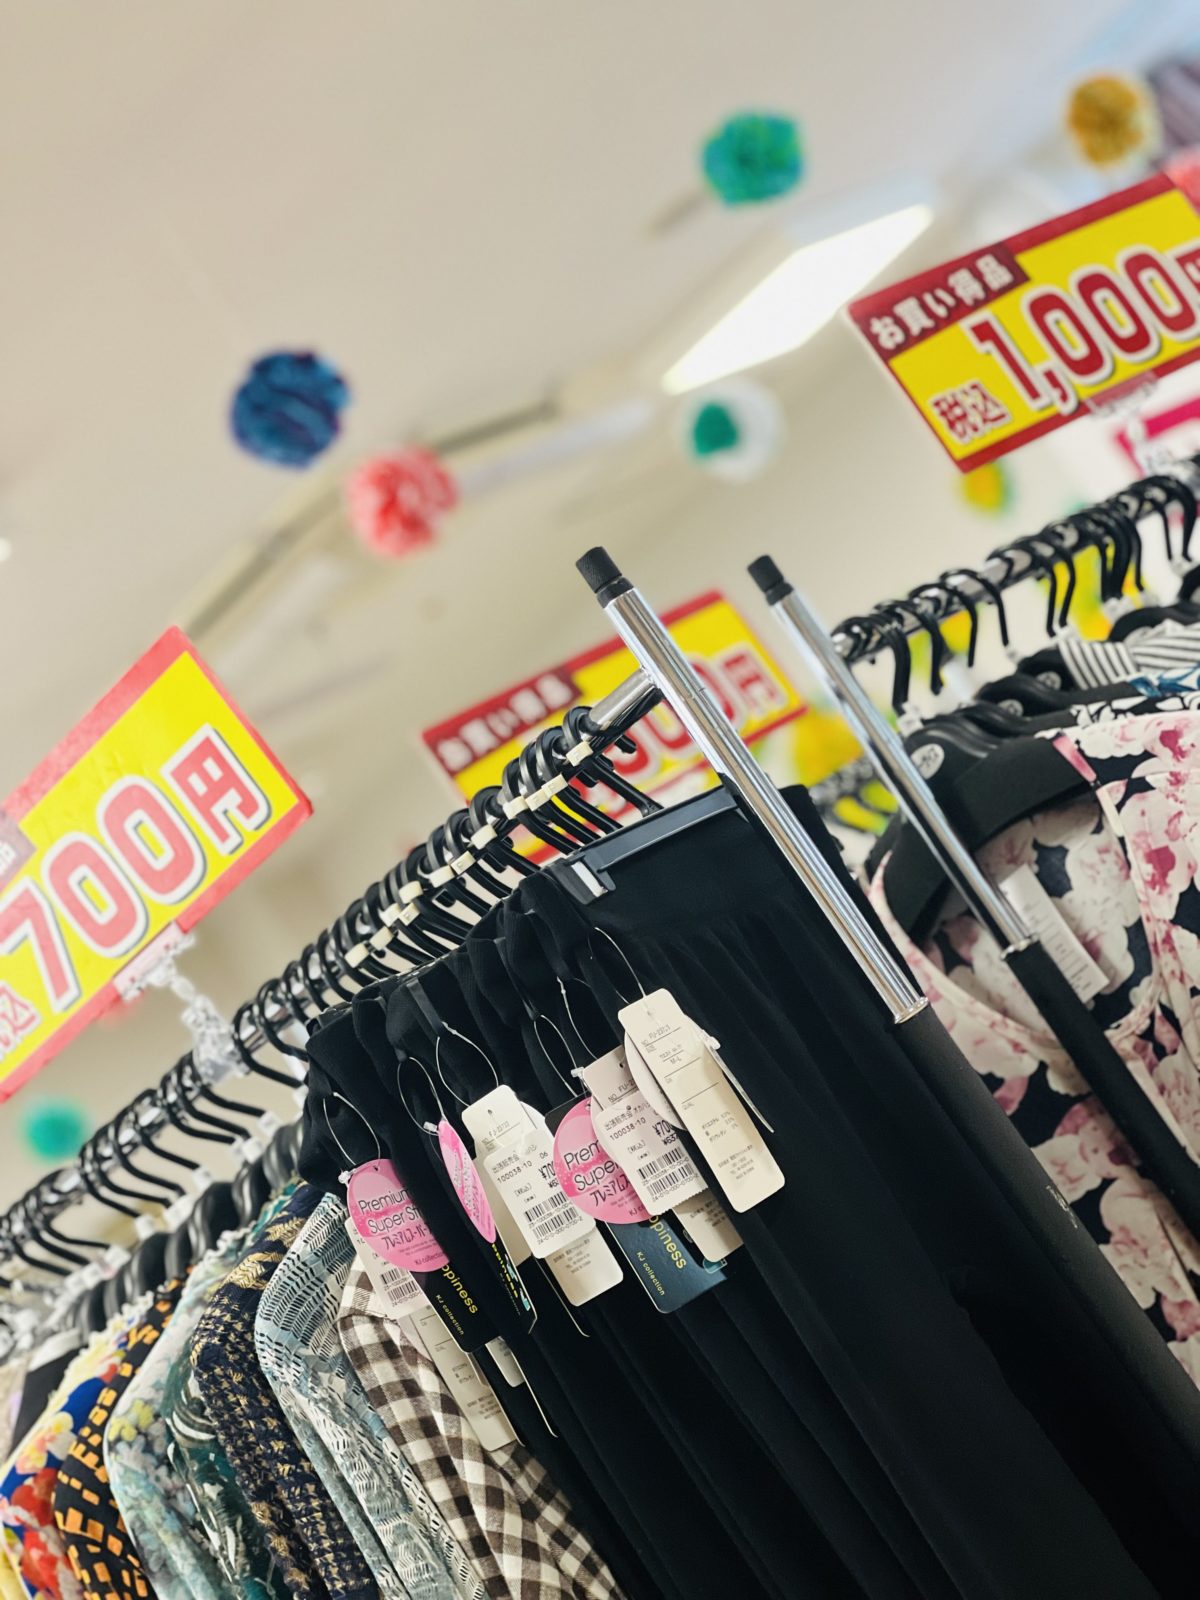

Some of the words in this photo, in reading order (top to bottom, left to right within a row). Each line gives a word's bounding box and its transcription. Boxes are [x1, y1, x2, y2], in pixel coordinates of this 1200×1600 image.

[497, 1160, 532, 1184] 100038-10
[367, 1210, 407, 1235] Super
[642, 1262, 666, 1296] collection
